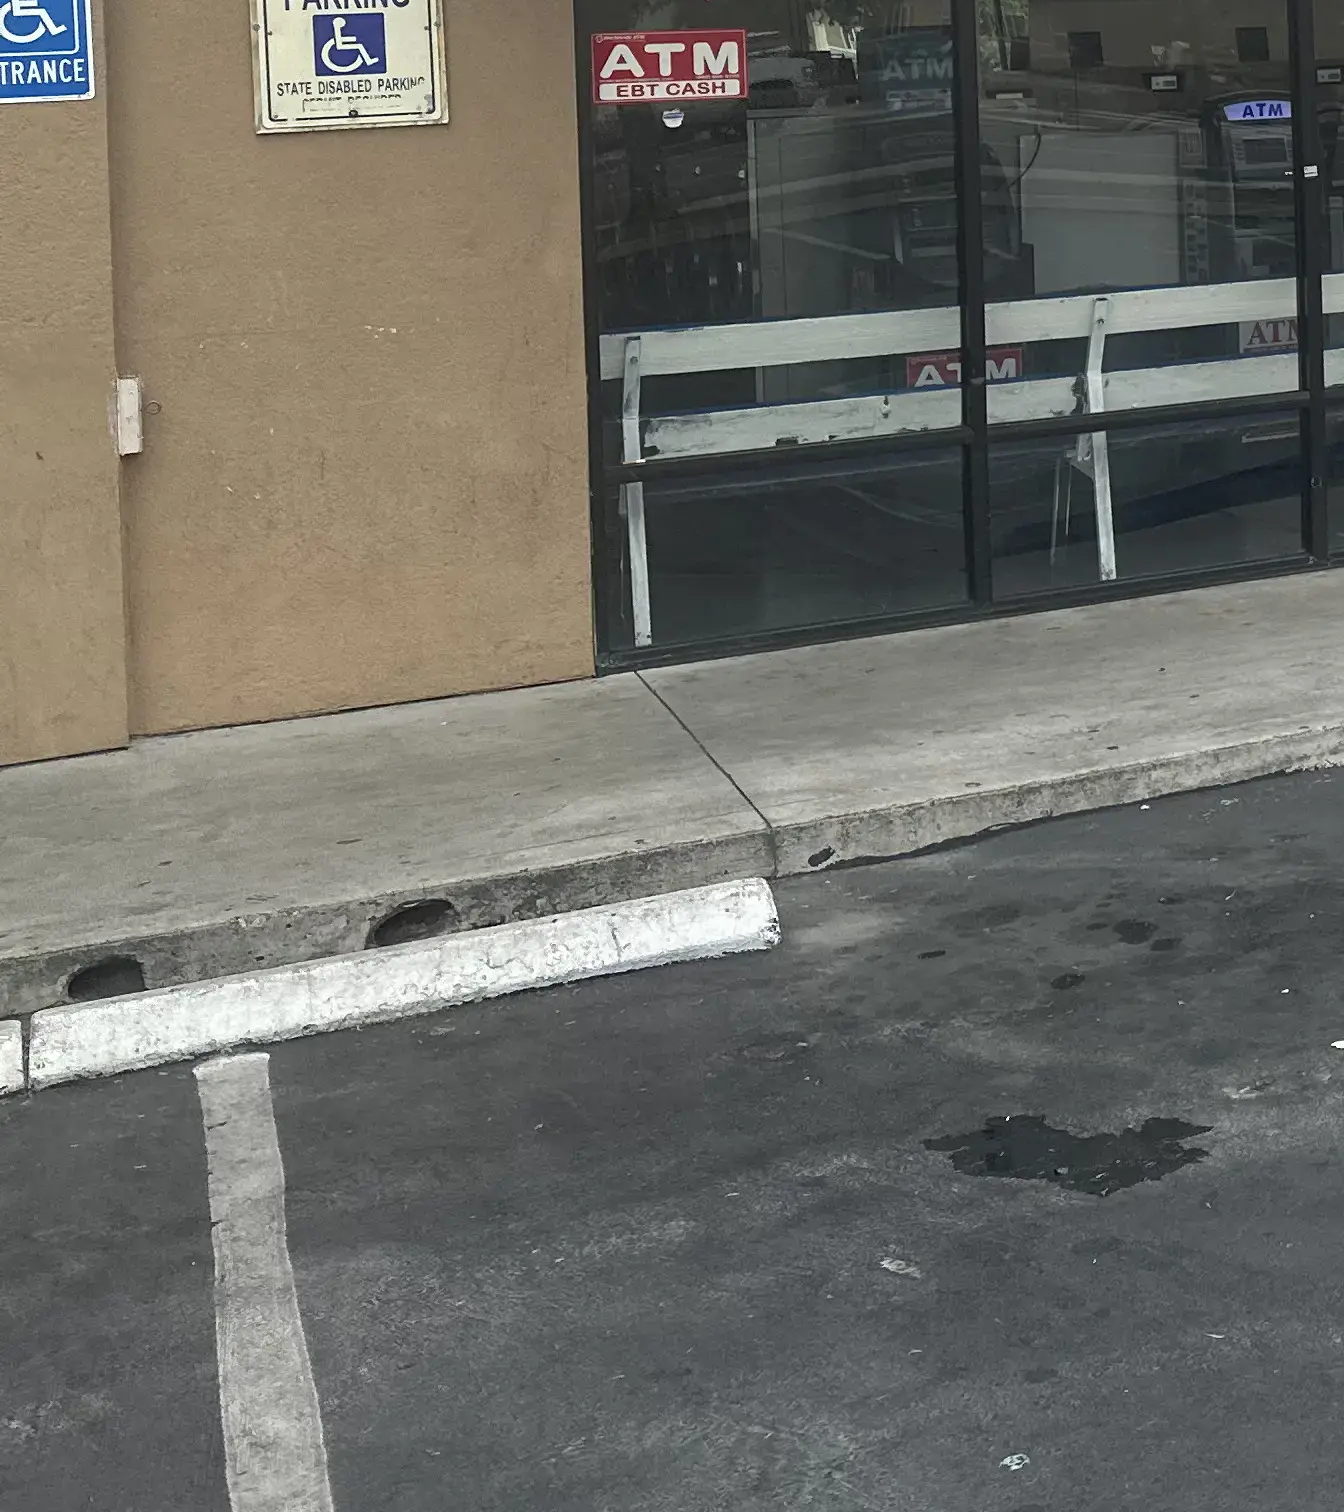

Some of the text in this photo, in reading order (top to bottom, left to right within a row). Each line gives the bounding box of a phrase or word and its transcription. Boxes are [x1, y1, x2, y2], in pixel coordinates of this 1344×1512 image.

[600, 41, 739, 79] ATM
[879, 57, 954, 81] ATM
[0, 58, 86, 85] TRANCE
[276, 82, 313, 97] STATE
[318, 79, 372, 95] DISABLED
[616, 81, 726, 98] EBT CASH
[1242, 102, 1284, 119] ATM
